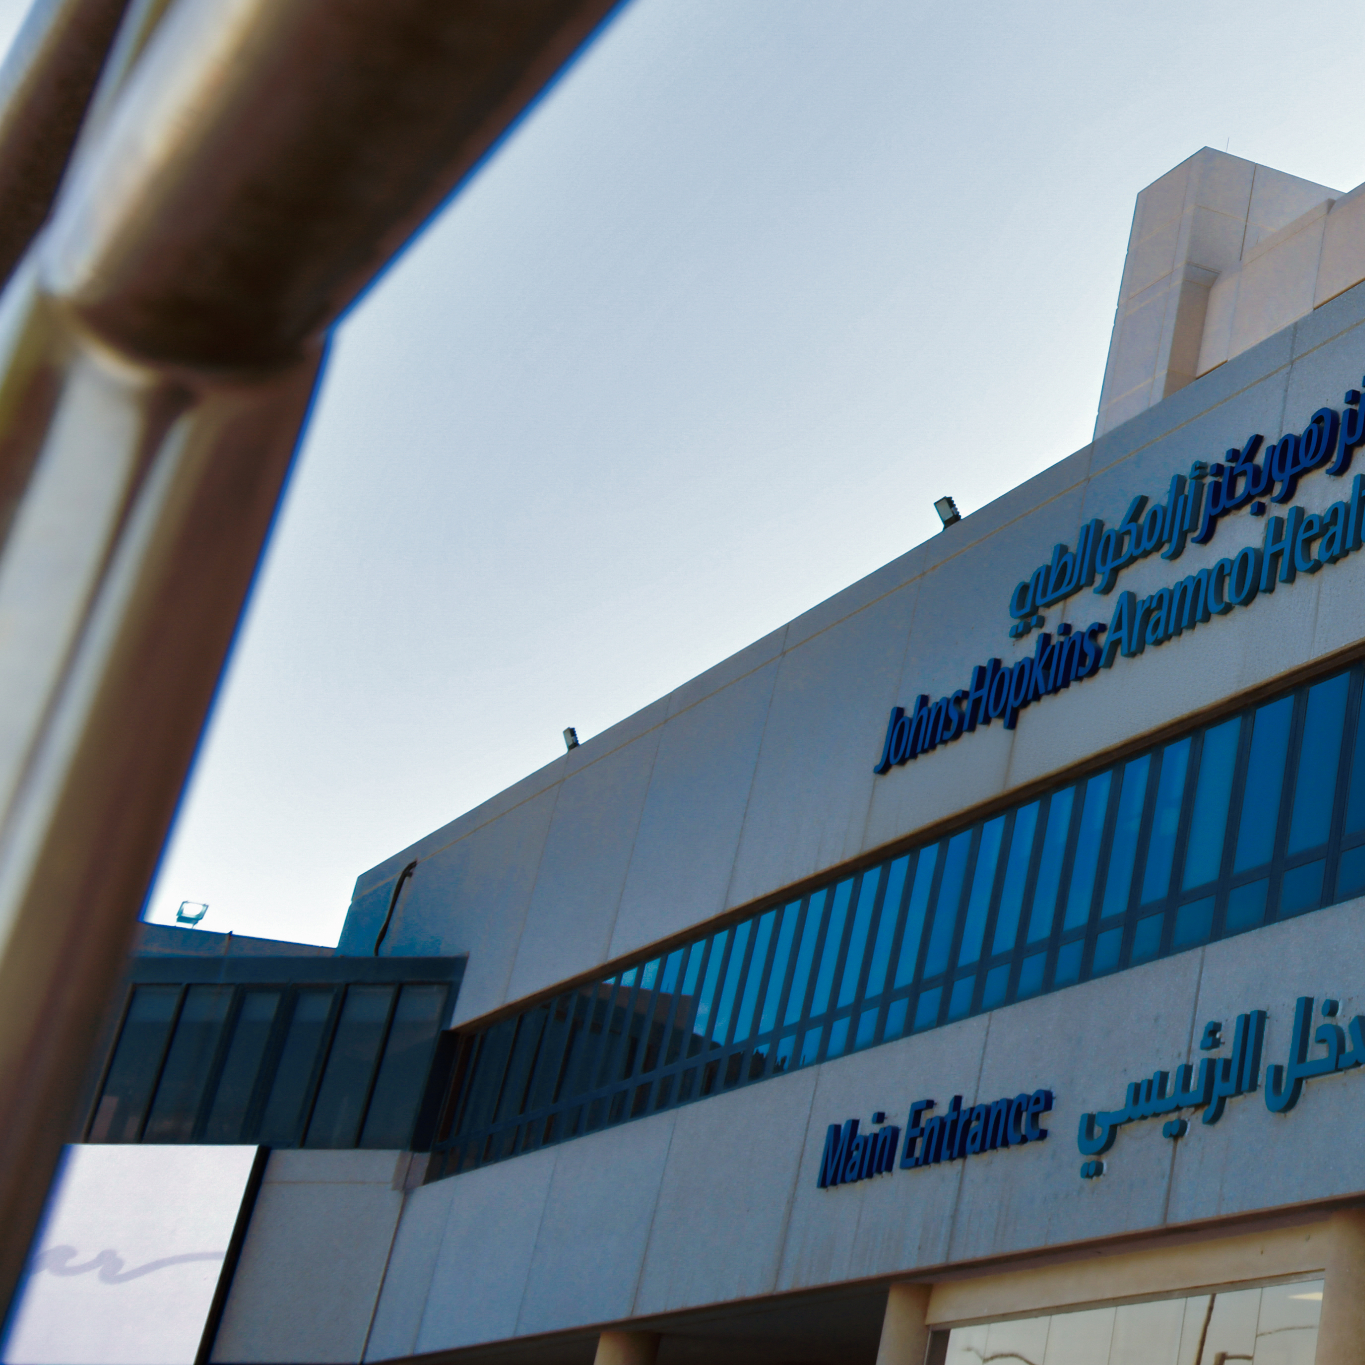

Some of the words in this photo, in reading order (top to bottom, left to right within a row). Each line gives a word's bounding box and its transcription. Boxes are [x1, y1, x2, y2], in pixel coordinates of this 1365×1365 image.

[1093, 460, 1208, 595] أرامكو
[1191, 407, 1340, 545] هوبكنز
[1009, 518, 1104, 638] الطبي
[873, 689, 969, 775] Johns
[963, 622, 1107, 730] Hopkins
[1099, 546, 1262, 669] Aramco
[817, 1111, 899, 1188] Main
[899, 1088, 1053, 1169] Entrance
[1077, 1009, 1267, 1179] الرئيسي
